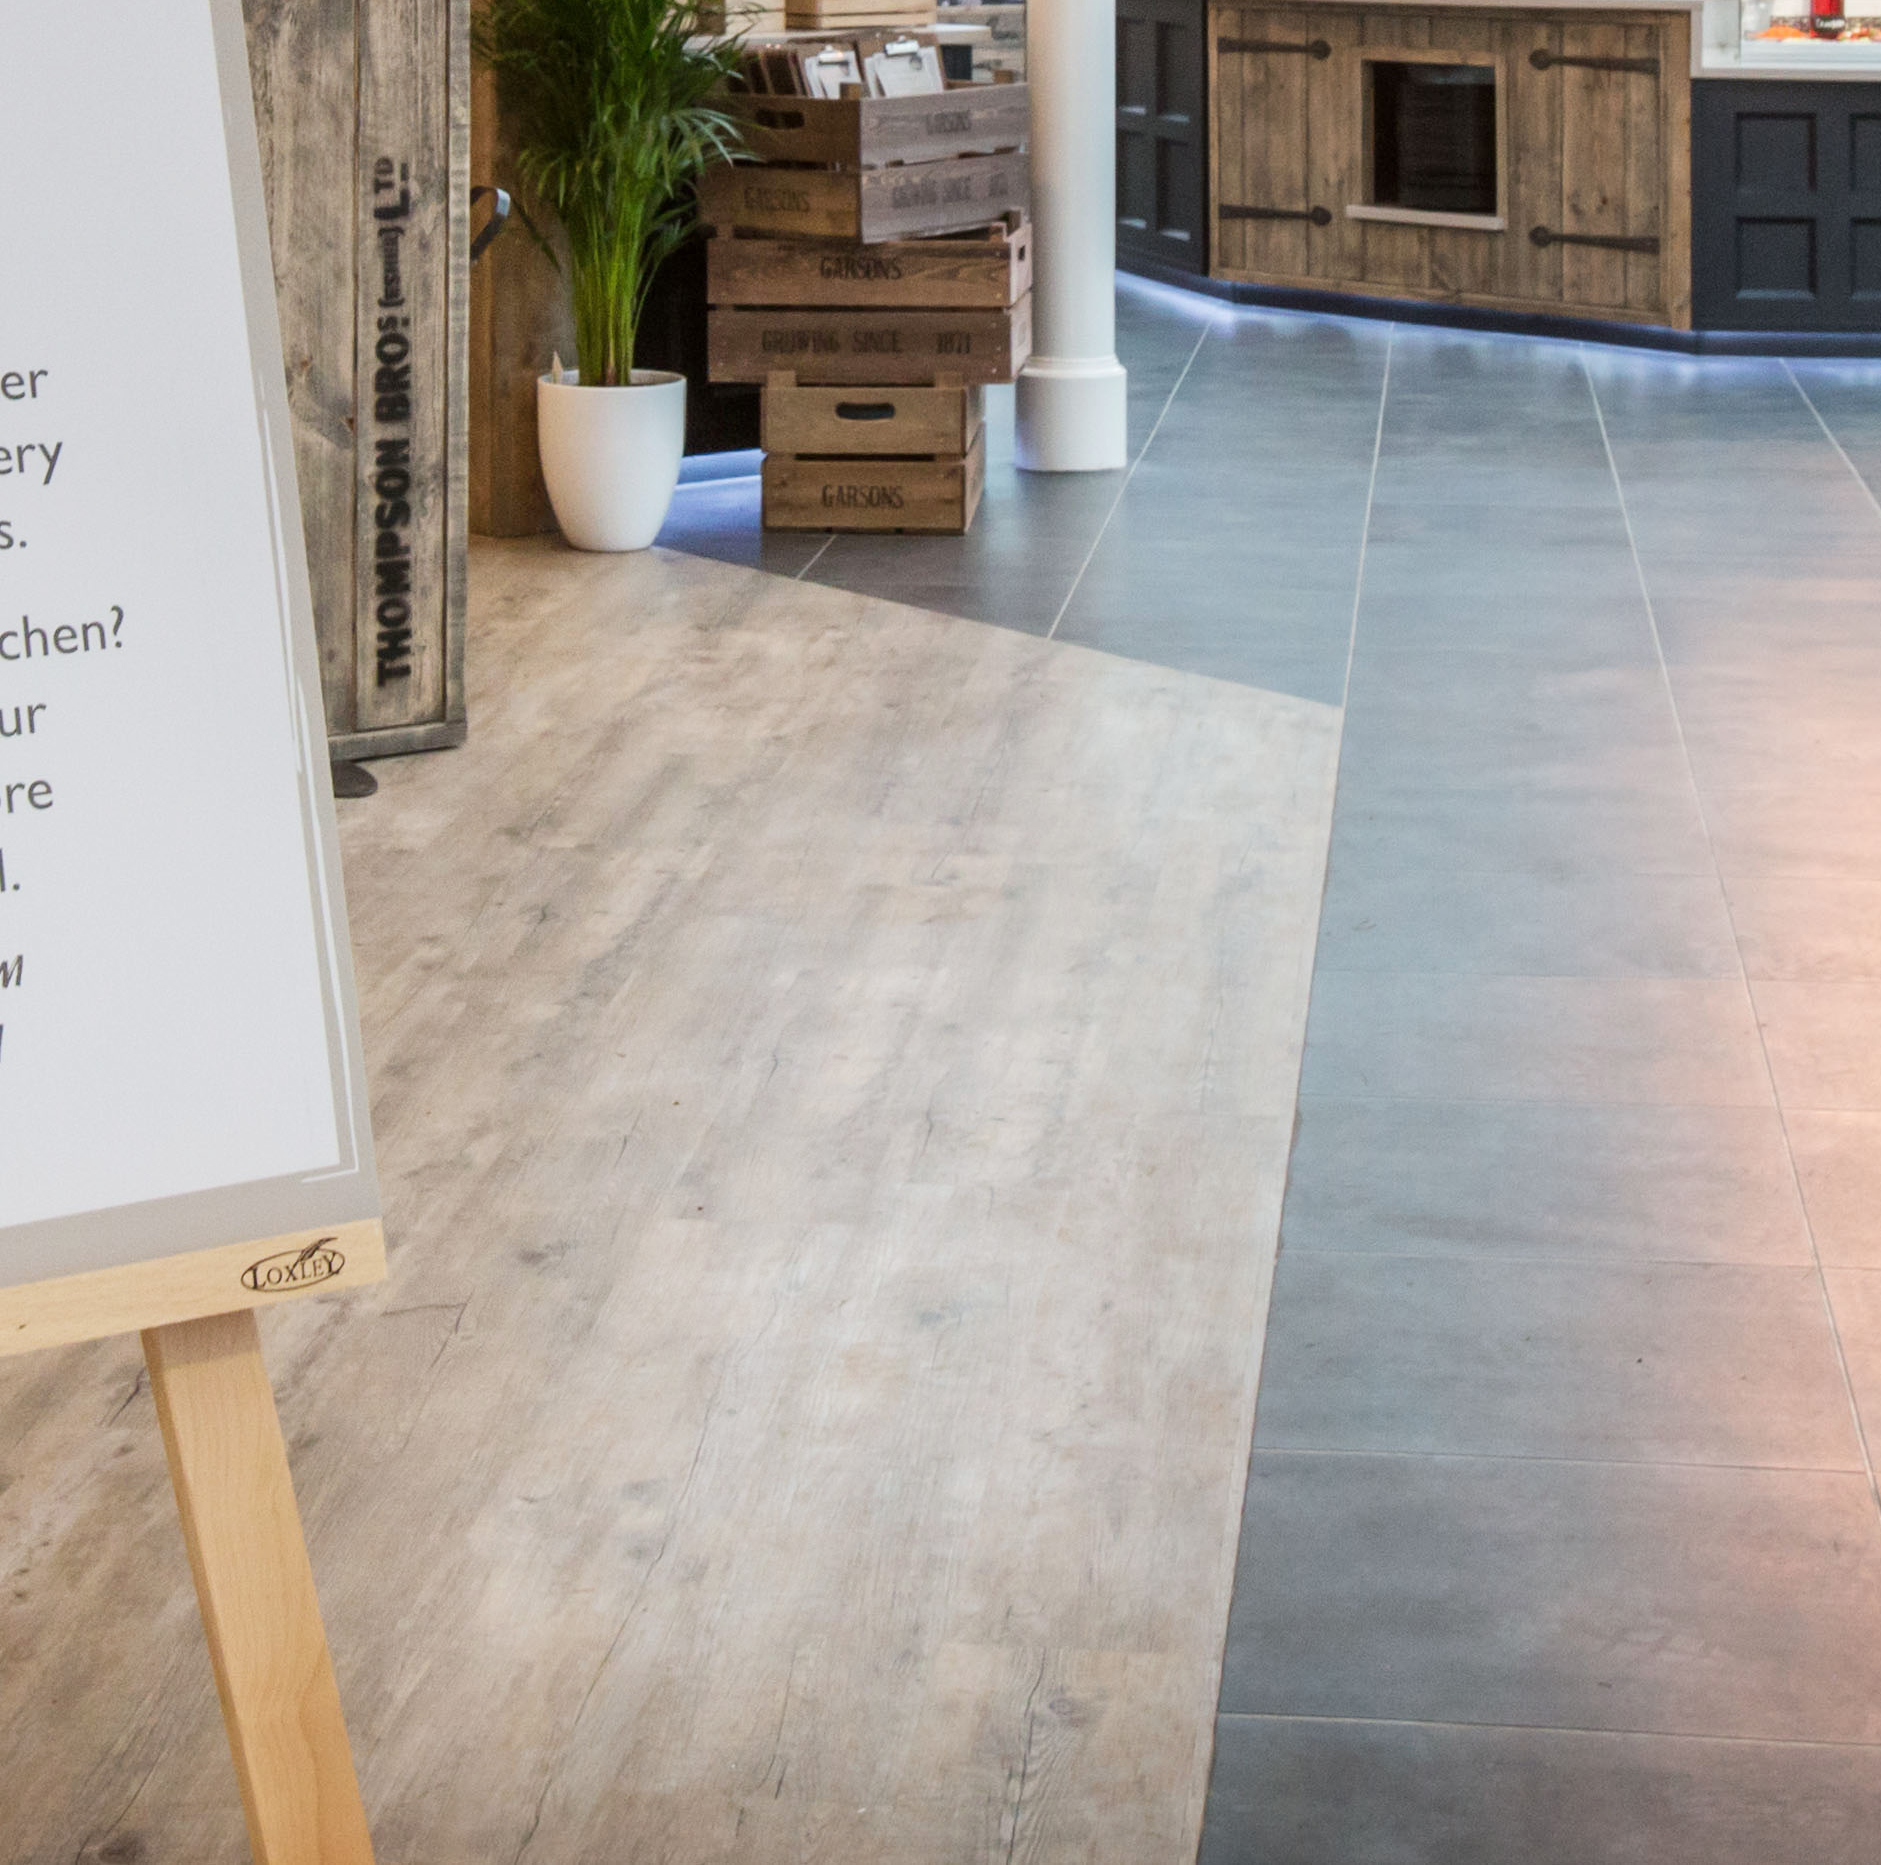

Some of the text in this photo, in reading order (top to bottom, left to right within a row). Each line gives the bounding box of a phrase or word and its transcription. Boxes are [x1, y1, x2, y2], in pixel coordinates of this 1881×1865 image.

[819, 255, 903, 282] GARSONS
[852, 330, 902, 355] SINCE
[821, 484, 905, 509] GARSONS
[374, 438, 412, 688] THOMPSON
[251, 1252, 342, 1290] LOXLEY
